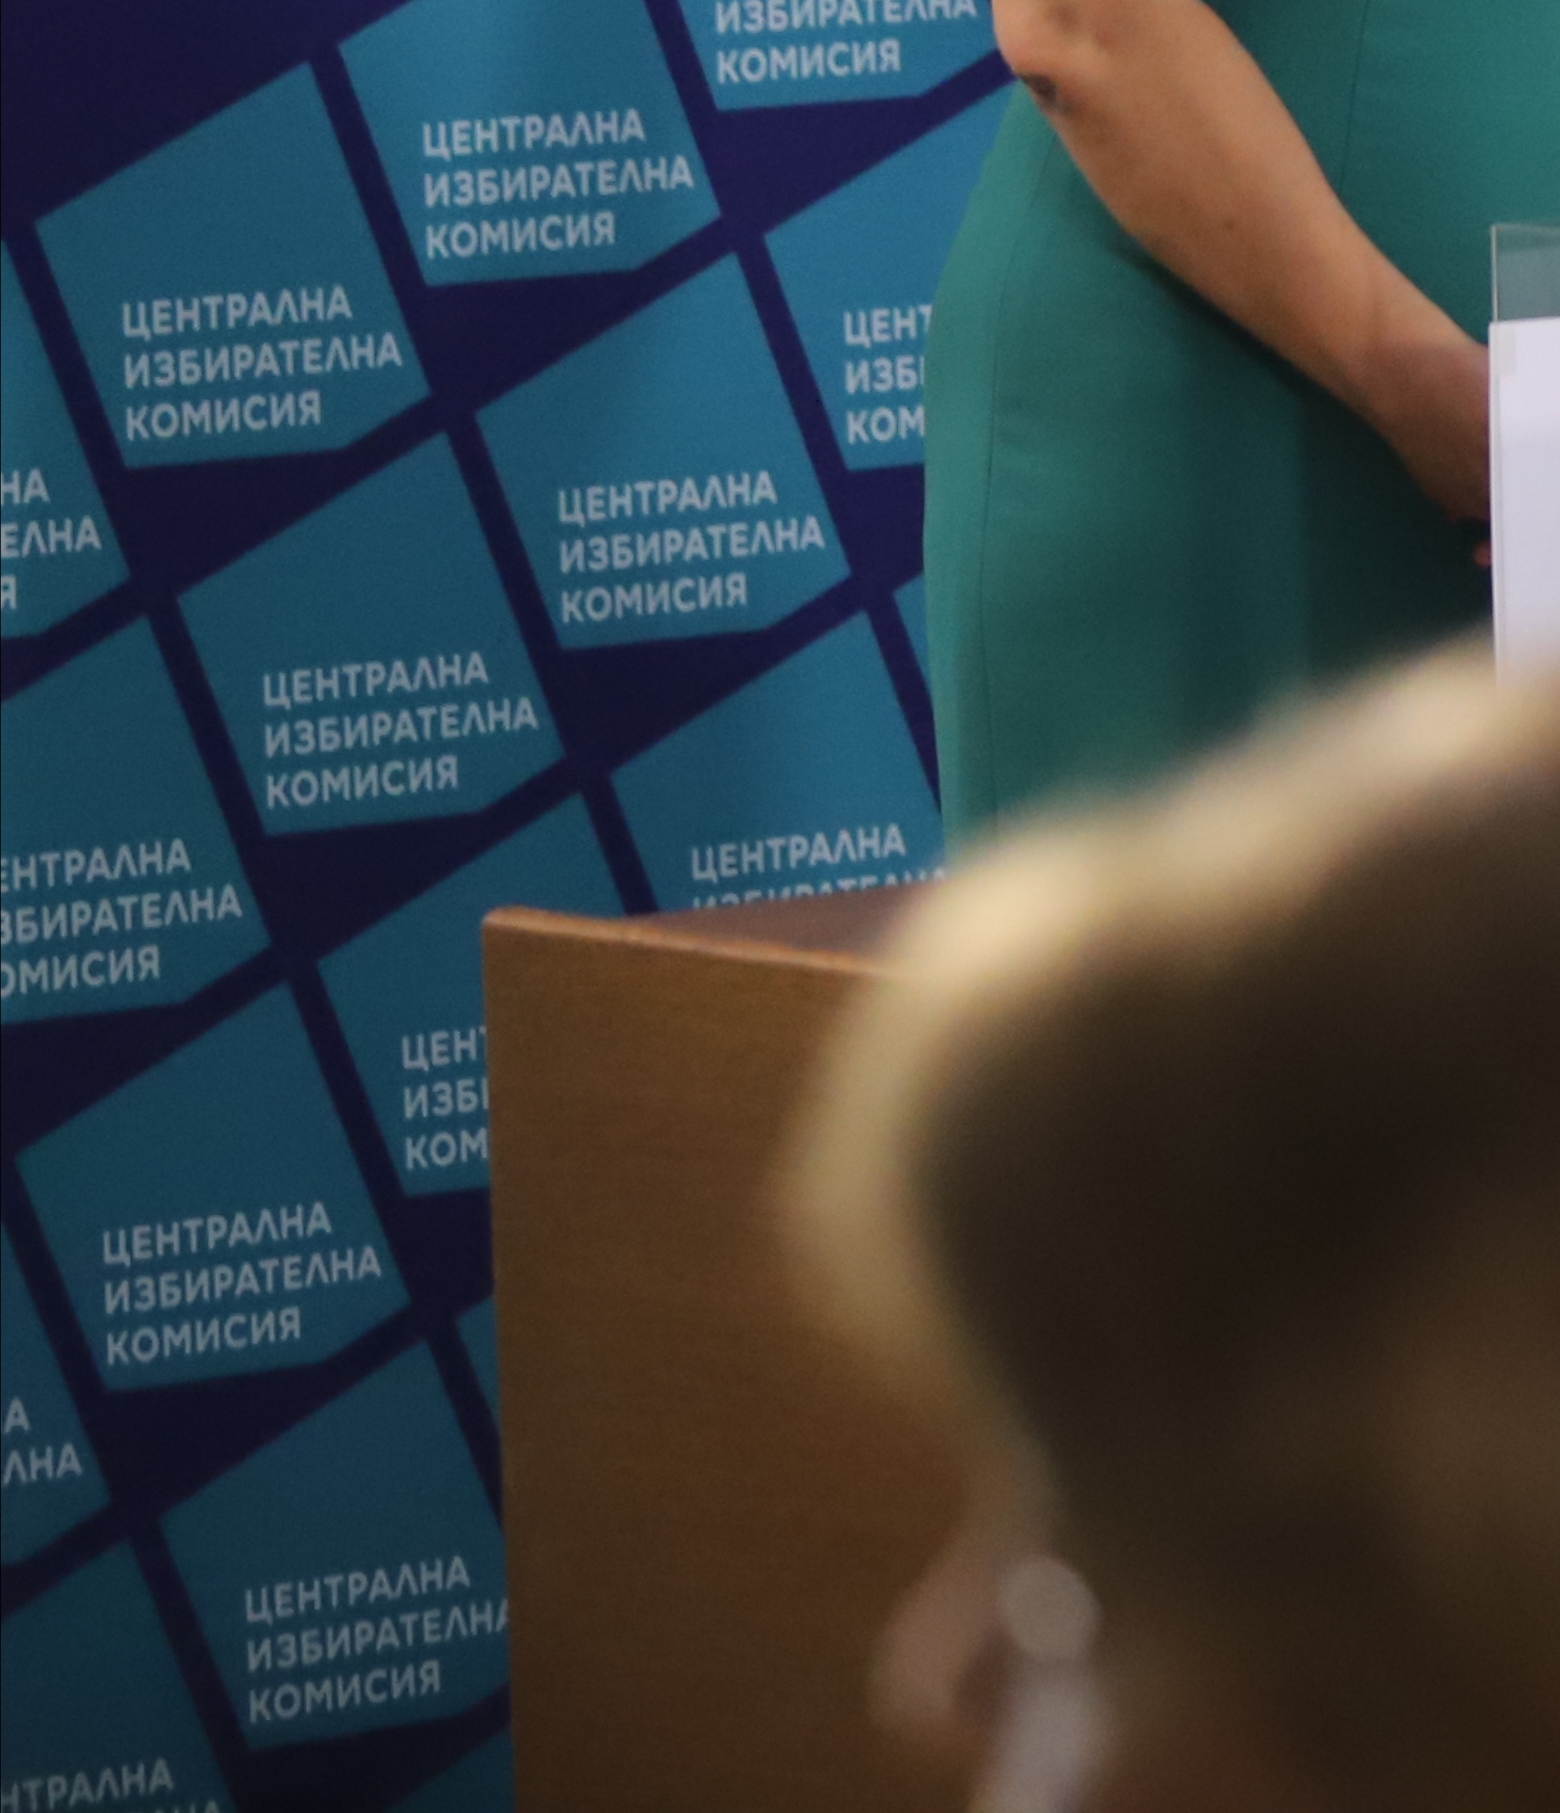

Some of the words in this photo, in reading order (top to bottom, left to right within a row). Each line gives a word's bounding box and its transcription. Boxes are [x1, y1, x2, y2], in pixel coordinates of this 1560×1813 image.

[716, 37, 902, 85] КОМИСИЯ
[422, 108, 646, 161] ЦЕНТРАЛНА
[423, 155, 695, 210] ИЗБИРАТЕЛНА
[425, 211, 617, 260] КОМИСИЯ
[121, 284, 353, 341] ЦЕНТРАЛНА
[123, 332, 402, 389] ИЗБИРАТЕЛНА
[125, 389, 322, 443] КОМИСИЯ
[557, 470, 778, 528] ЦЕНТРАЛНА
[559, 515, 825, 575] ИЗБИРАТЕЛНА
[560, 572, 749, 625] КОМИСИЯ
[262, 651, 490, 711] ЦЕНТРАЛНА
[263, 697, 539, 760] ИЗБИРАТЕЛНА
[265, 755, 460, 811] КОМИСИЯ
[691, 822, 907, 884] ЦЕНТРАЛНА
[101, 1199, 332, 1270] ЦЕНТРАЛНА
[104, 1243, 382, 1317] ИЗБИРАТЕЛНА
[105, 1305, 303, 1368] КОМИСИЯ
[244, 1555, 472, 1626] ЦЕНТРАЛНА
[248, 1658, 443, 1725] КОМИСИЯ
